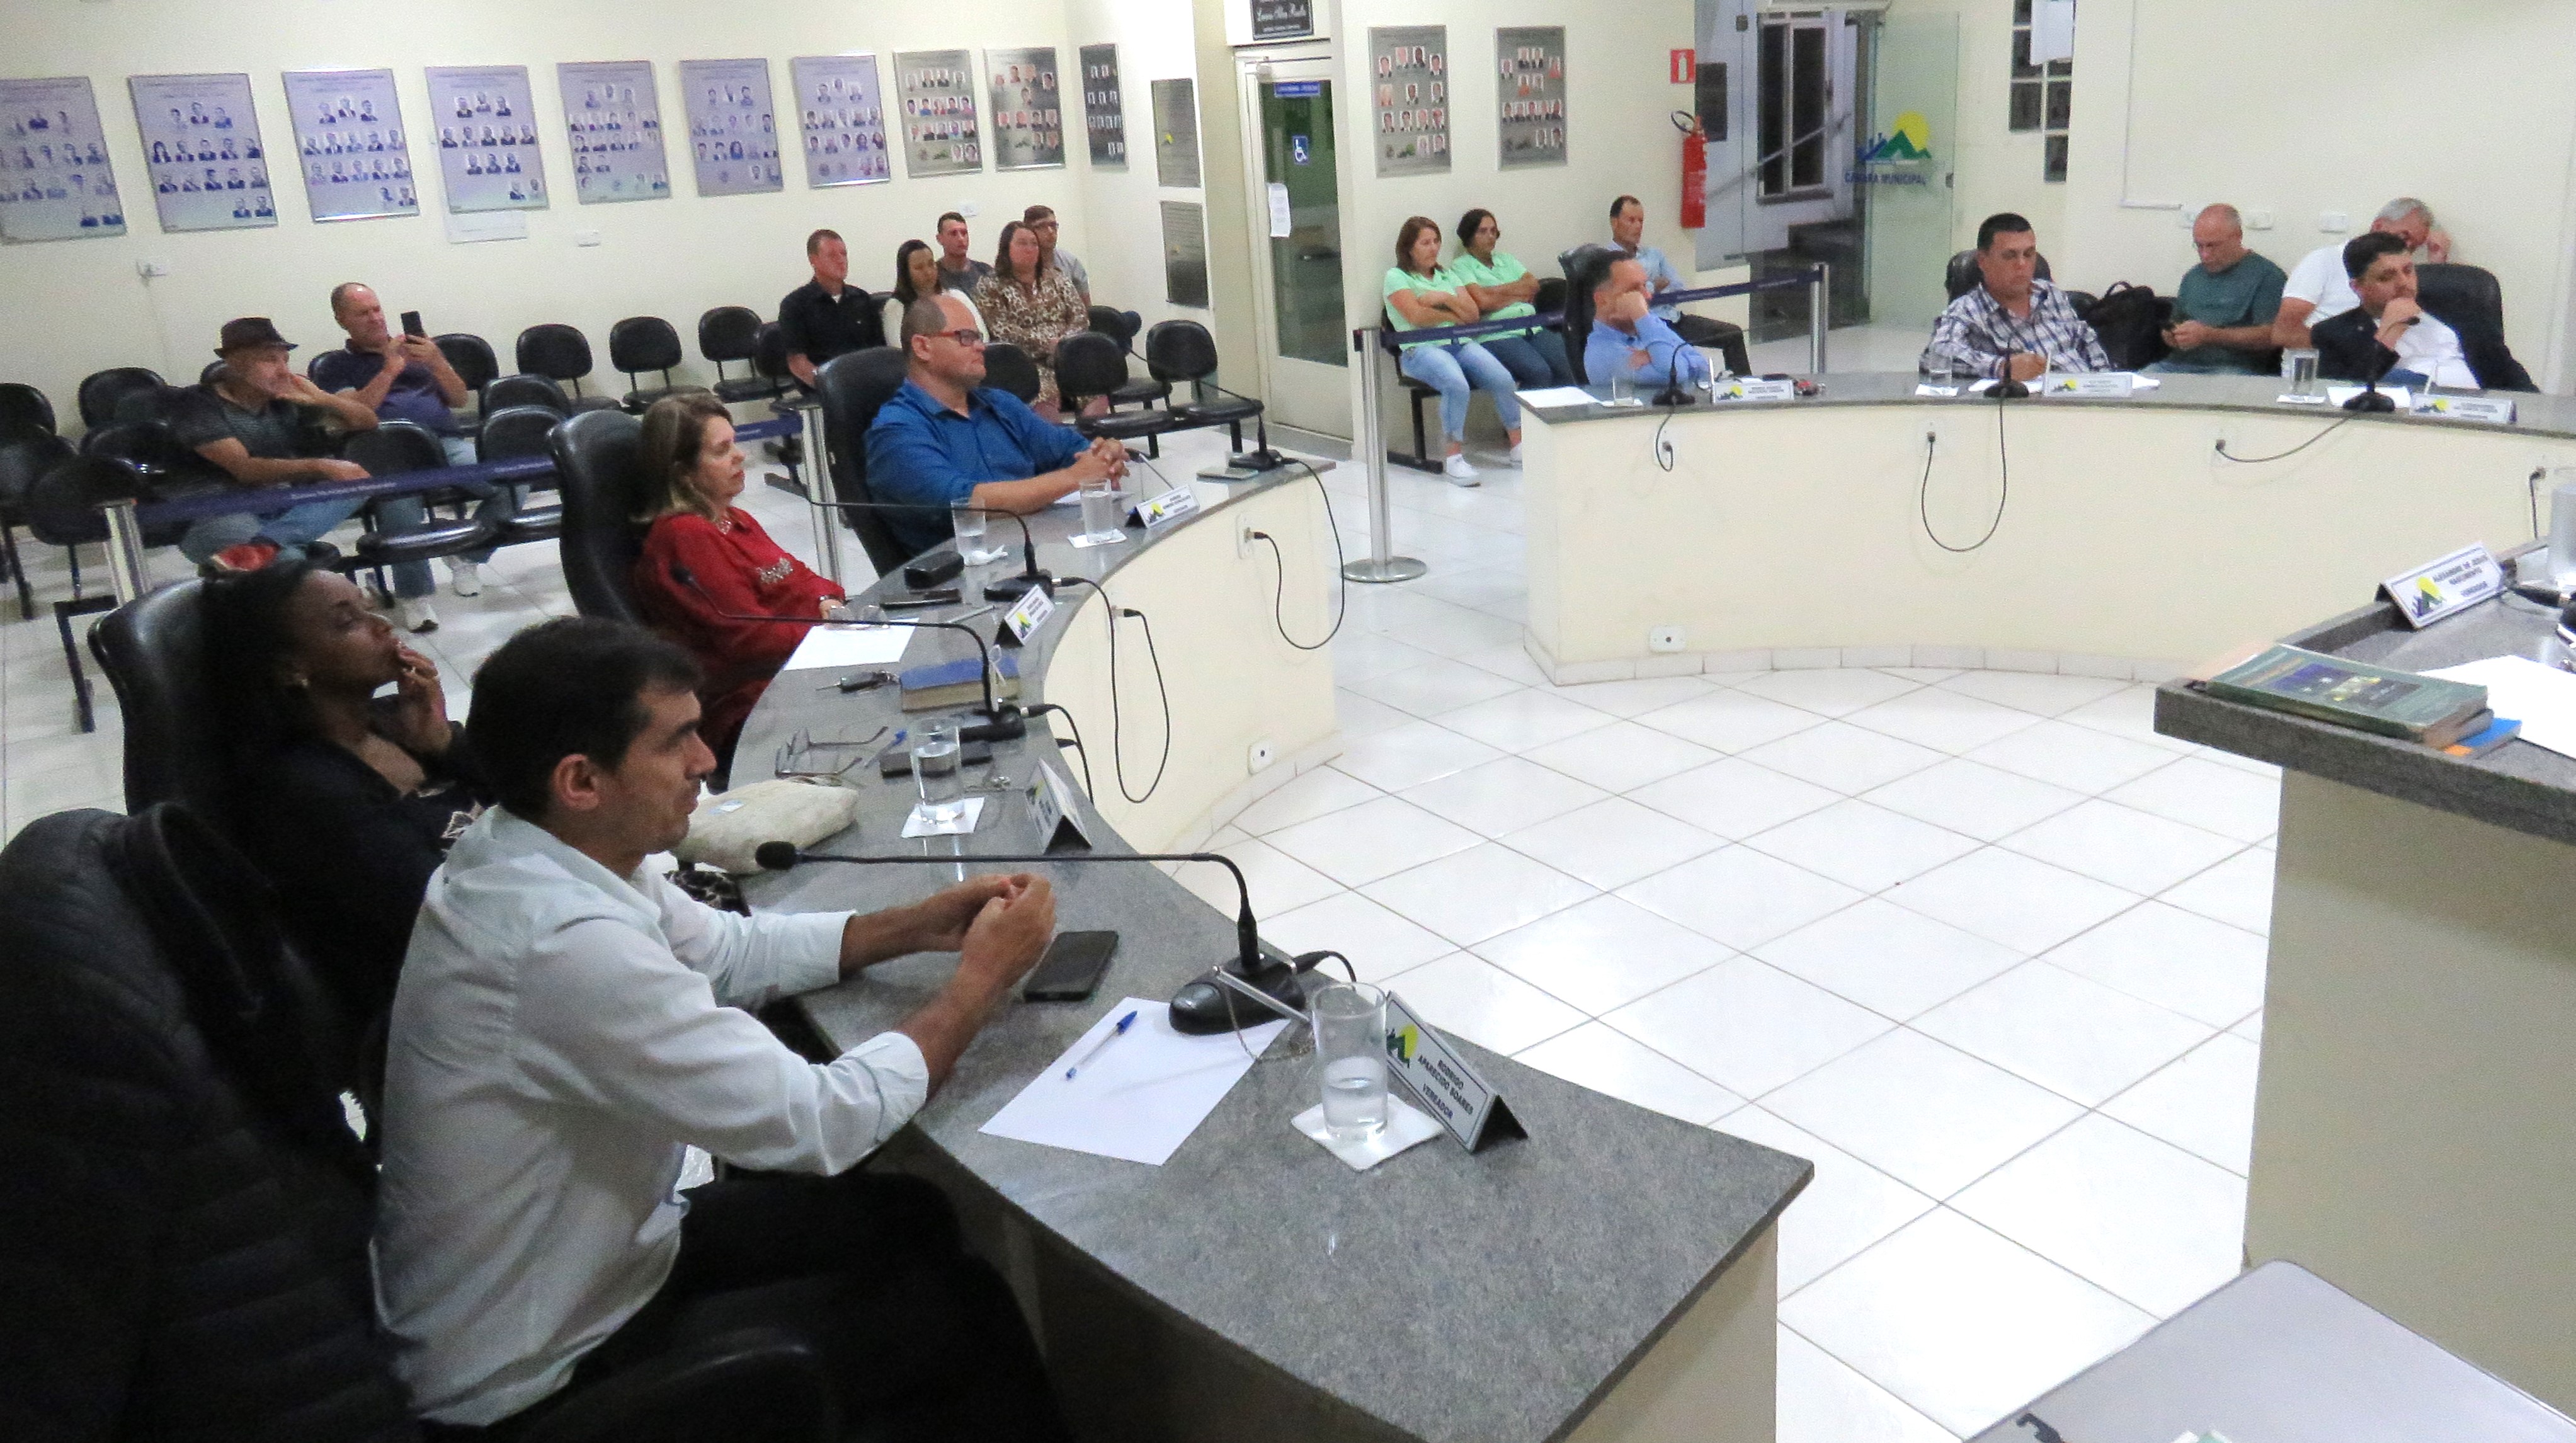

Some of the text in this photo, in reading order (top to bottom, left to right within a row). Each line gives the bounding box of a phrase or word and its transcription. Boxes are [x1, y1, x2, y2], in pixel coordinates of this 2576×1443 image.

[1881, 173, 1926, 186] MUNICIPAL
[1418, 1054, 1473, 1115] APARECIDO SOARES
[1437, 1059, 1464, 1090] RODRIGO
[1422, 1083, 1454, 1119] VEREADOR
